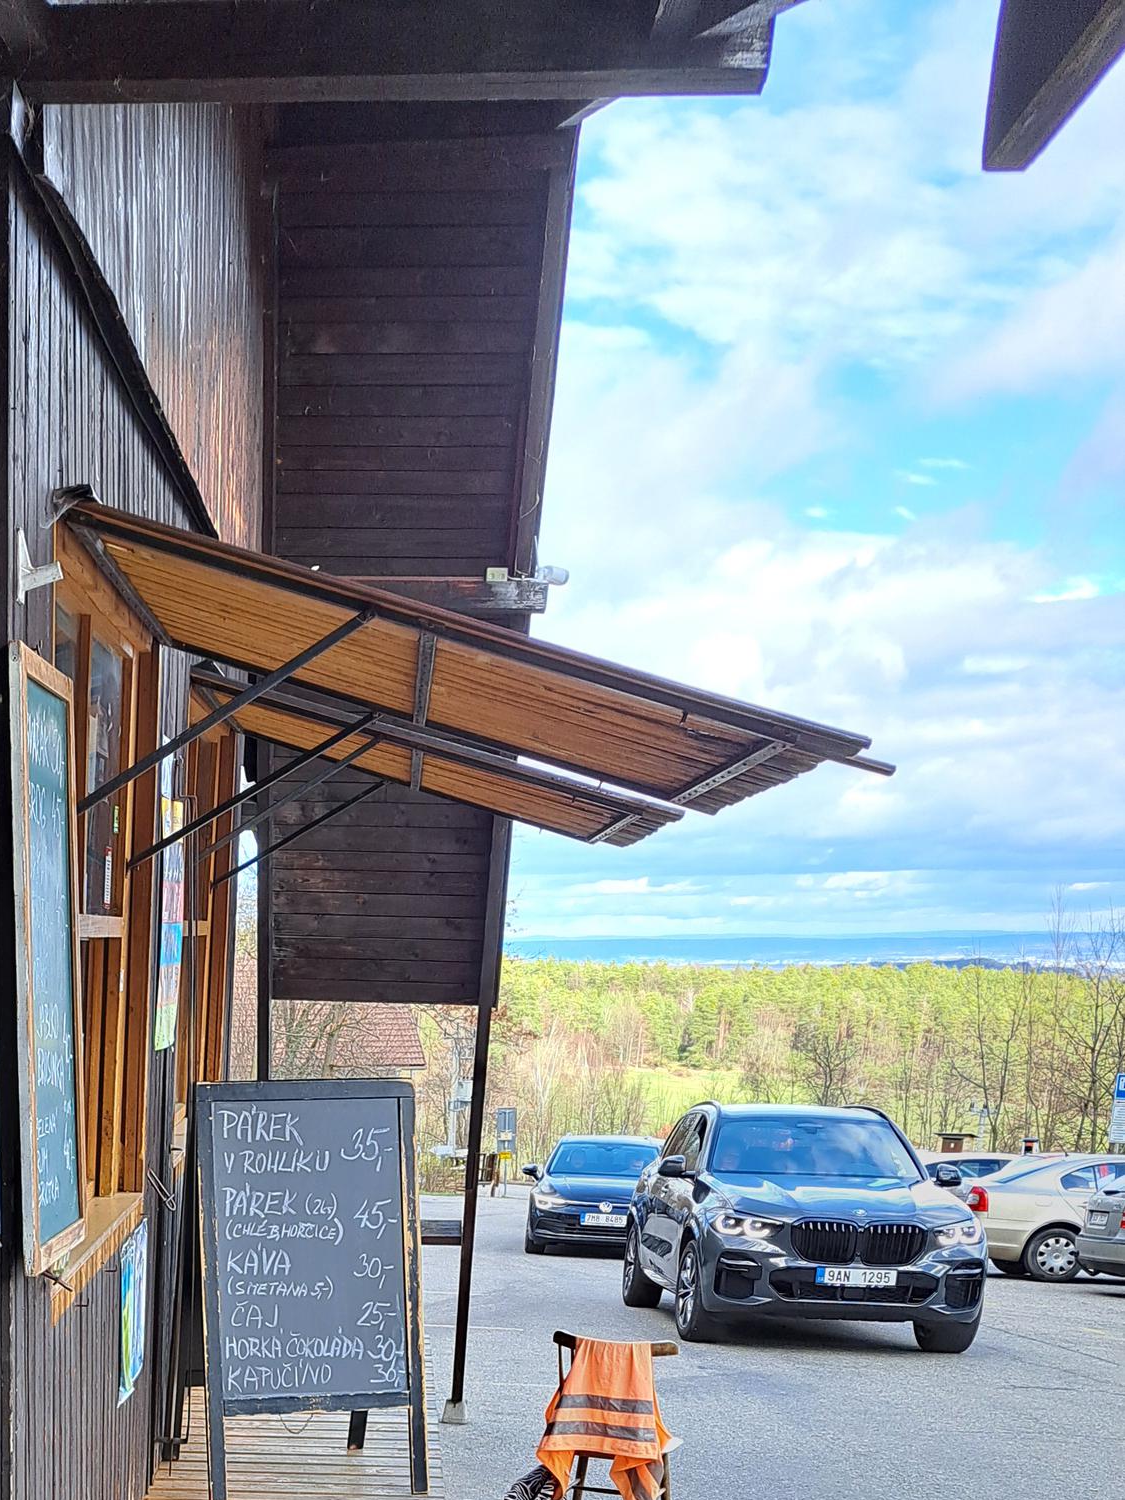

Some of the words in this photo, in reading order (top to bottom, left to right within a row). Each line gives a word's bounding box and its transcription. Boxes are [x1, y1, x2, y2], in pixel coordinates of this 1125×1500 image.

[217, 1104, 304, 1146] PÁREK
[224, 1152, 235, 1173] V
[340, 1127, 393, 1172] 35,-
[222, 1182, 297, 1218] PÁREK
[353, 1199, 398, 1239] 45,-
[227, 1242, 292, 1276] KÁVA
[353, 1253, 394, 1289] 30,-
[828, 1270, 851, 1282] 9AN
[862, 1272, 891, 1283] 1295
[227, 1275, 308, 1297] (SMETANA
[231, 1301, 279, 1327] ČAJ
[357, 1302, 397, 1331] 25,-
[225, 1328, 283, 1360] HORKÁ
[286, 1326, 364, 1360] ČOKOLÁDA
